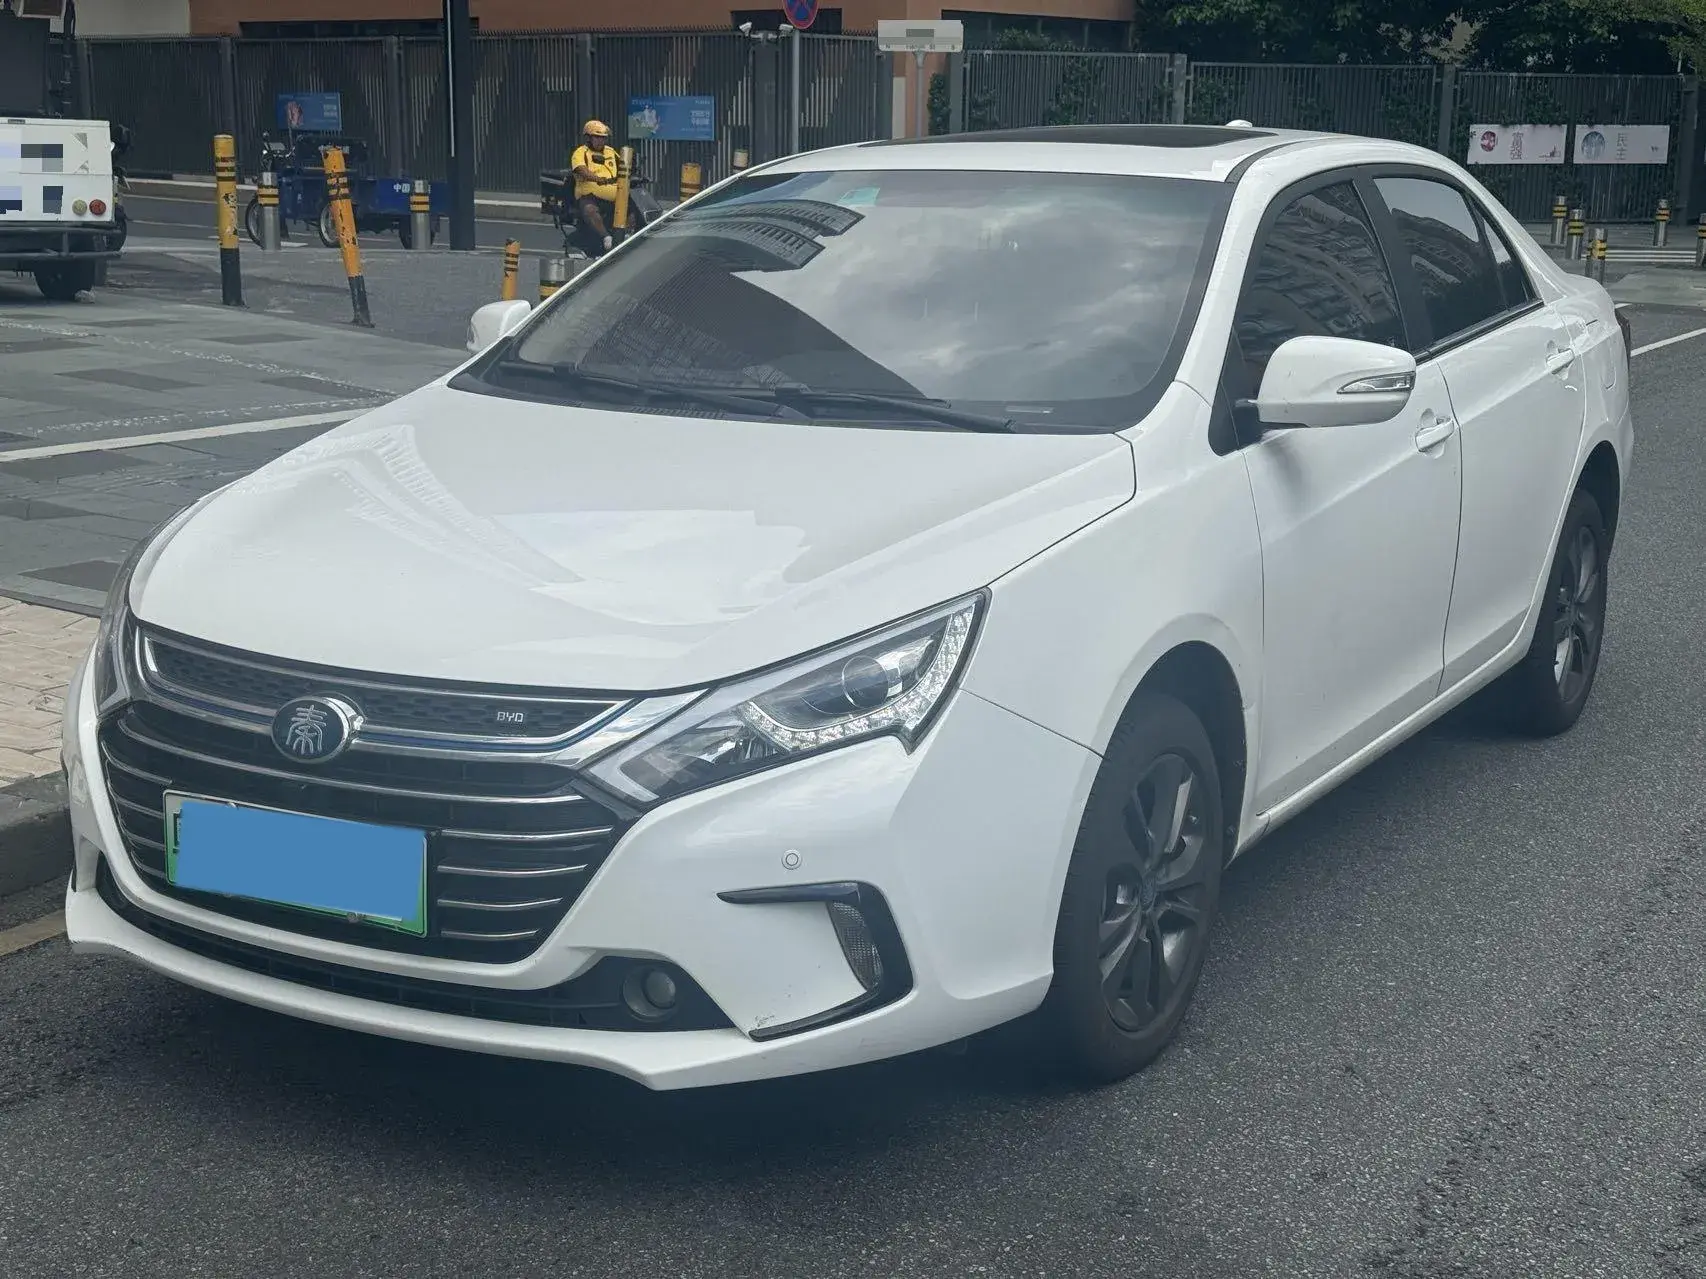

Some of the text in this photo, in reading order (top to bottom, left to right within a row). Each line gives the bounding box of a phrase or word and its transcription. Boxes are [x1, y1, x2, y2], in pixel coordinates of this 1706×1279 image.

[1510, 132, 1524, 160] 富强
[1615, 132, 1628, 160] 民主
[496, 711, 524, 722] BYD
